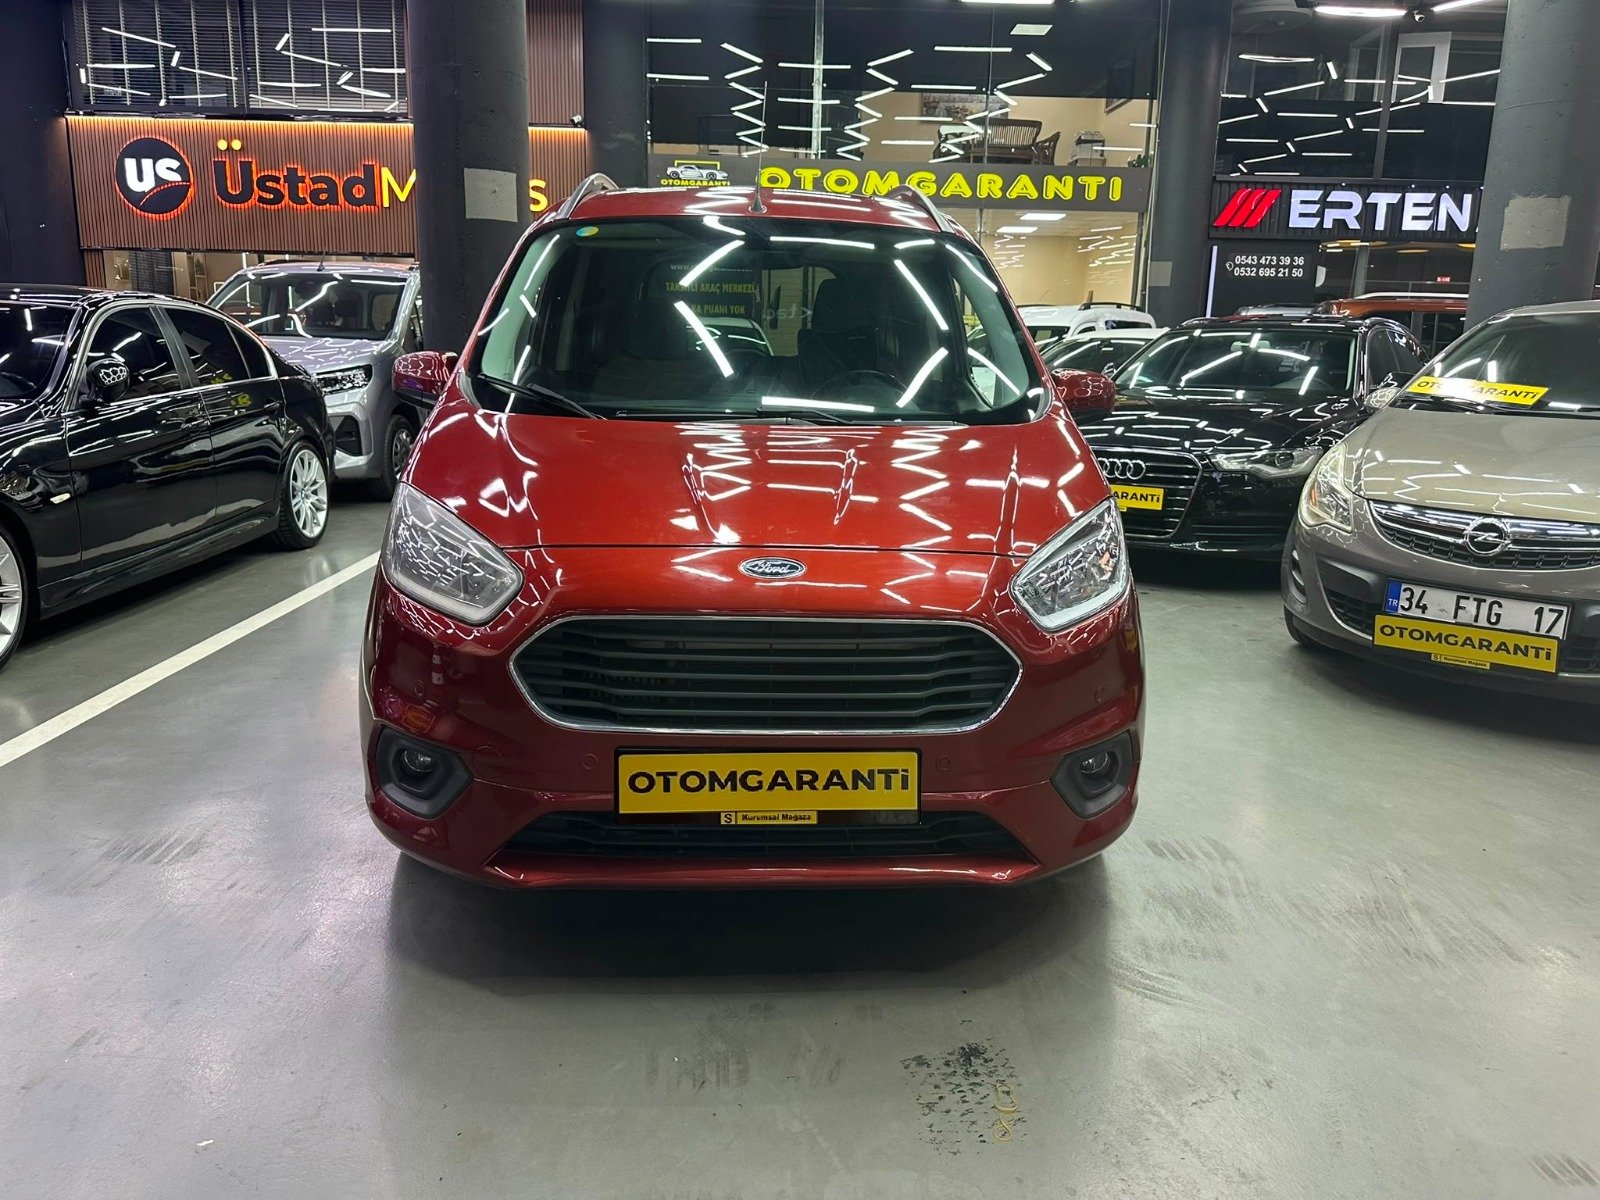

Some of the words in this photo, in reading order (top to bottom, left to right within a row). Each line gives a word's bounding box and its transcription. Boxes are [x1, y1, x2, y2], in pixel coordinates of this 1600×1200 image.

[660, 179, 731, 187] OTOMGARANTI
[760, 166, 1122, 202] OTOMGARANTI
[1288, 189, 1478, 232] ERTEN
[1234, 255, 1258, 265] 0543
[1260, 255, 1277, 266] 473
[1279, 256, 1291, 266] 39
[1292, 256, 1305, 266] 36
[1233, 267, 1257, 277] 0532
[1258, 267, 1276, 277] 695
[1277, 267, 1289, 277] 21
[1291, 267, 1304, 278] 50
[730, 305, 746, 314] YOK
[1113, 490, 1160, 503] ARANTi
[1388, 598, 1399, 607] TR
[1400, 586, 1429, 615] 34
[1453, 594, 1504, 627] FTG
[1533, 606, 1565, 635] 17
[724, 813, 733, 823] S
[741, 813, 780, 821] Kurumsal
